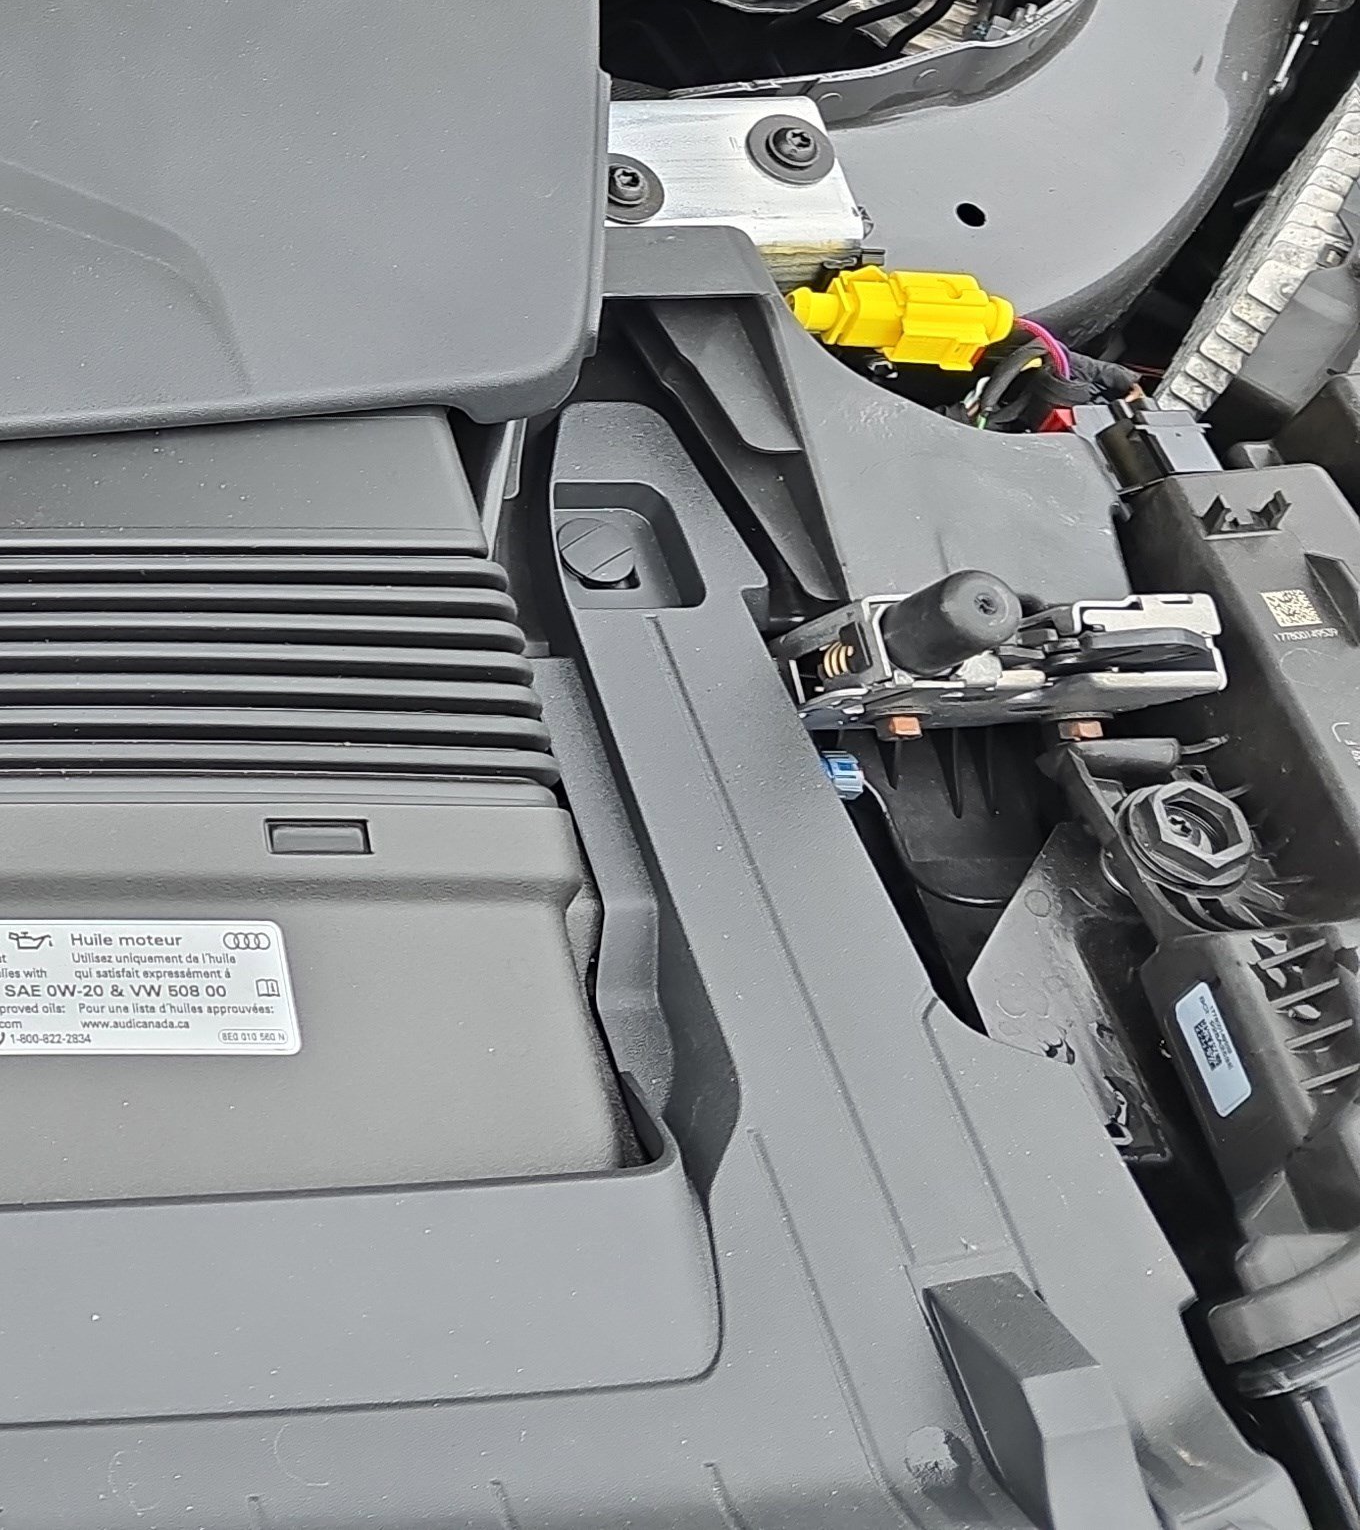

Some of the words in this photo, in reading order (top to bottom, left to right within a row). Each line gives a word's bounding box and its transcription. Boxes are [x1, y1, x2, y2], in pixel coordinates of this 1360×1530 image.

[71, 933, 113, 946] Huile
[119, 934, 182, 946] moteur
[71, 952, 112, 964] Utilisez
[116, 953, 183, 966] uniquement
[185, 953, 199, 964] de
[25, 968, 47, 978] with
[74, 970, 92, 980] qui
[96, 969, 140, 979] satisfait
[4, 984, 42, 998] SAE
[46, 984, 104, 998] 0W-20
[110, 984, 125, 998] &
[130, 984, 162, 998] VW
[168, 984, 200, 998] 508
[205, 984, 227, 998] 00
[42, 1003, 65, 1014] oils:
[78, 1003, 106, 1014] Pour
[113, 1004, 129, 1014] une
[132, 1003, 156, 1014] liste
[80, 1019, 190, 1030] www.audicanada.ca
[10, 1034, 91, 1044] 1-800-822-2834
